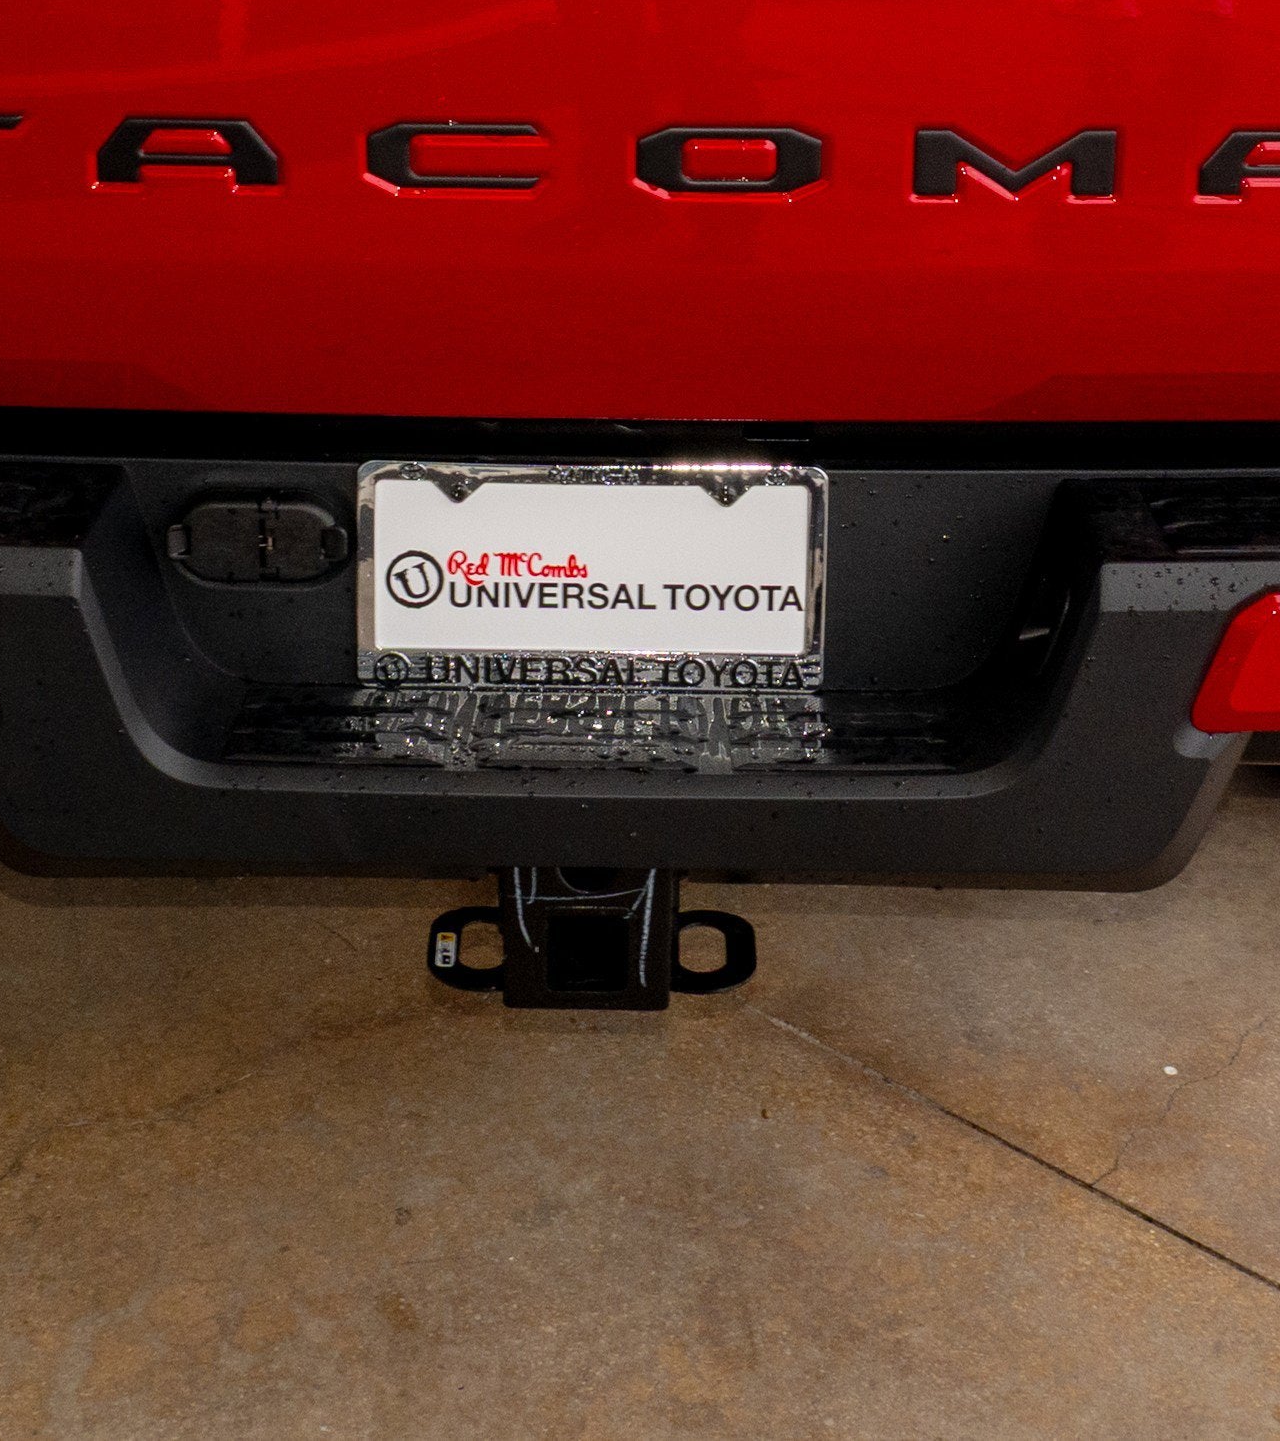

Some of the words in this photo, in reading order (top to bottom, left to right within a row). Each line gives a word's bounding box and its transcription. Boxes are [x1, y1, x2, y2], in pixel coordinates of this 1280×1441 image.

[447, 550, 490, 586] Red
[493, 552, 589, 579] McCombs
[448, 581, 656, 610] UNIVERSAL
[663, 583, 805, 612] TOYOTA
[424, 656, 650, 686] UNIVERSAL
[660, 657, 806, 689] TOYOTA
